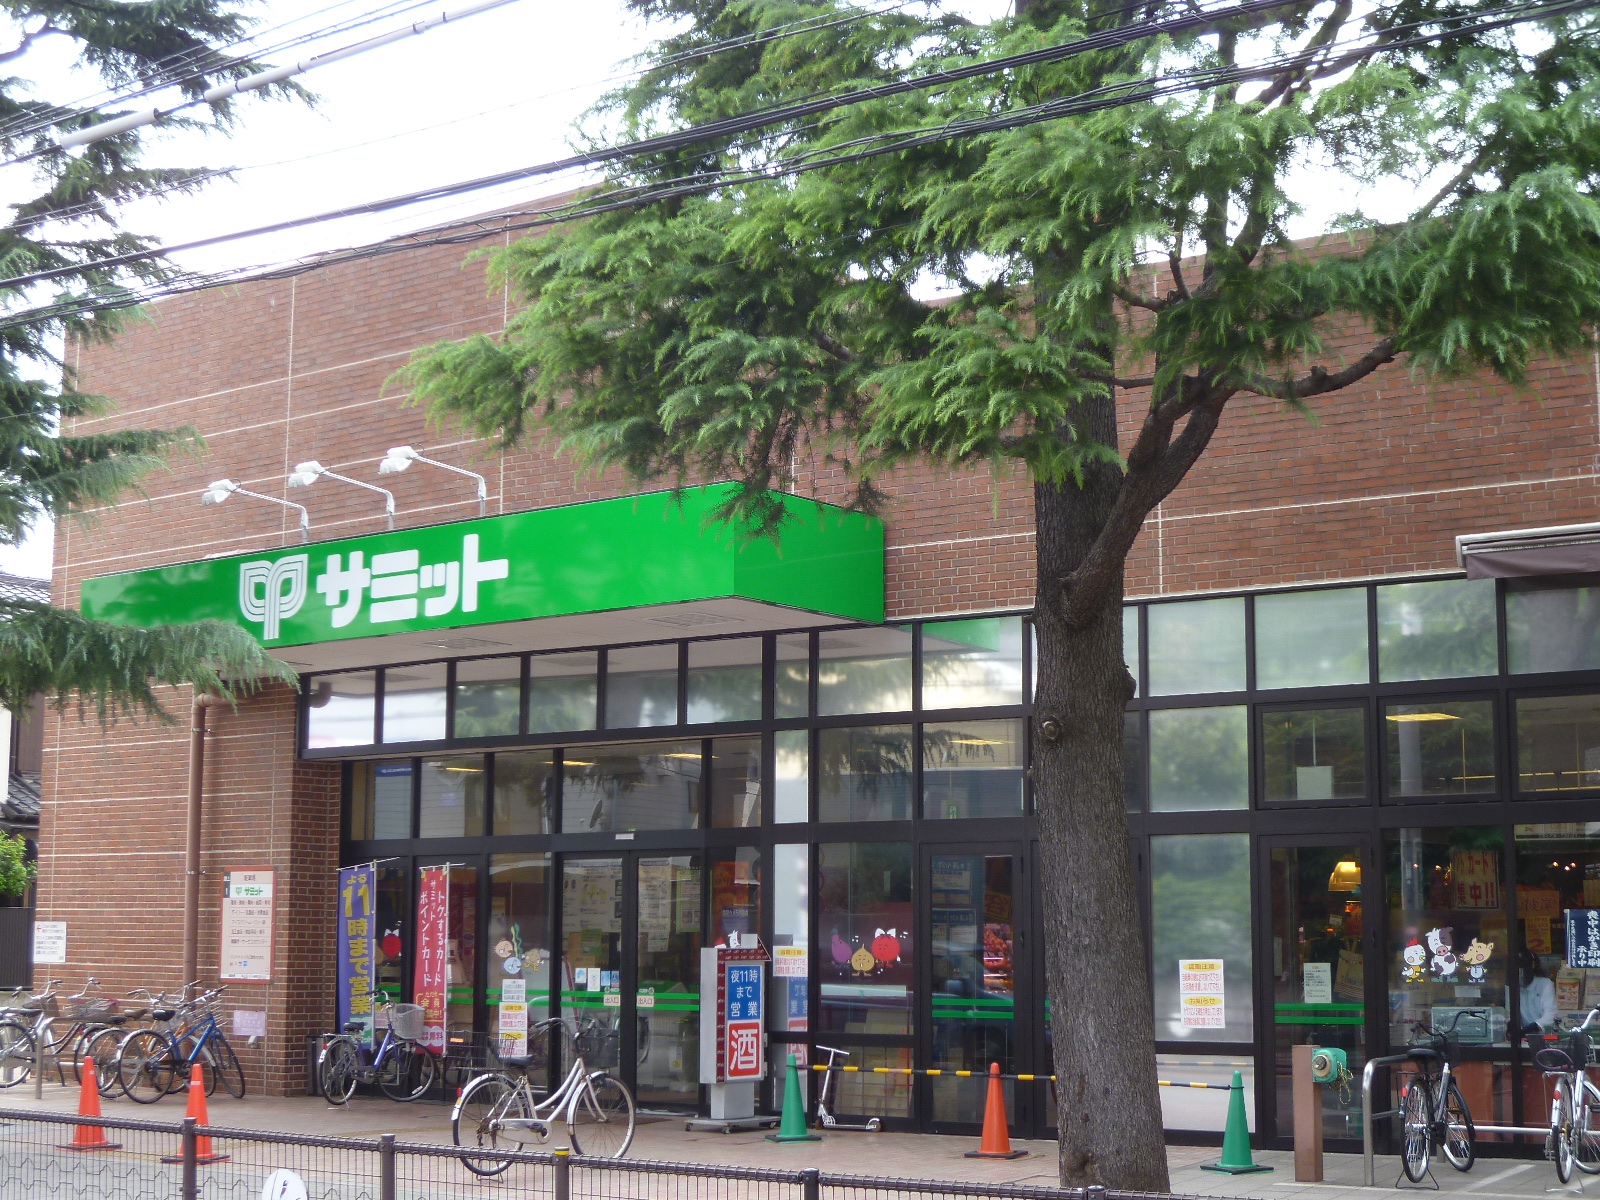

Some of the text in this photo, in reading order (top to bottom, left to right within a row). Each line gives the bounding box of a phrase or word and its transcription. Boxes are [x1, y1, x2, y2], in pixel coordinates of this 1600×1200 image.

[317, 533, 509, 628] サミット
[346, 873, 367, 885] よる
[244, 887, 264, 896] サミット
[342, 884, 371, 917] 11
[429, 879, 437, 921] サミット
[420, 890, 432, 987] ポイントカード
[434, 890, 446, 985] トクするカード
[1577, 945, 1588, 967] 承り中
[347, 918, 372, 1015] 時まで営業
[730, 970, 758, 983] 夜11時
[605, 996, 619, 1004] 出入口
[638, 997, 653, 1005] 出入口
[736, 986, 753, 998] まで
[420, 998, 441, 1008] 会員
[730, 1001, 758, 1017] 営業
[730, 1028, 758, 1071] 酒
